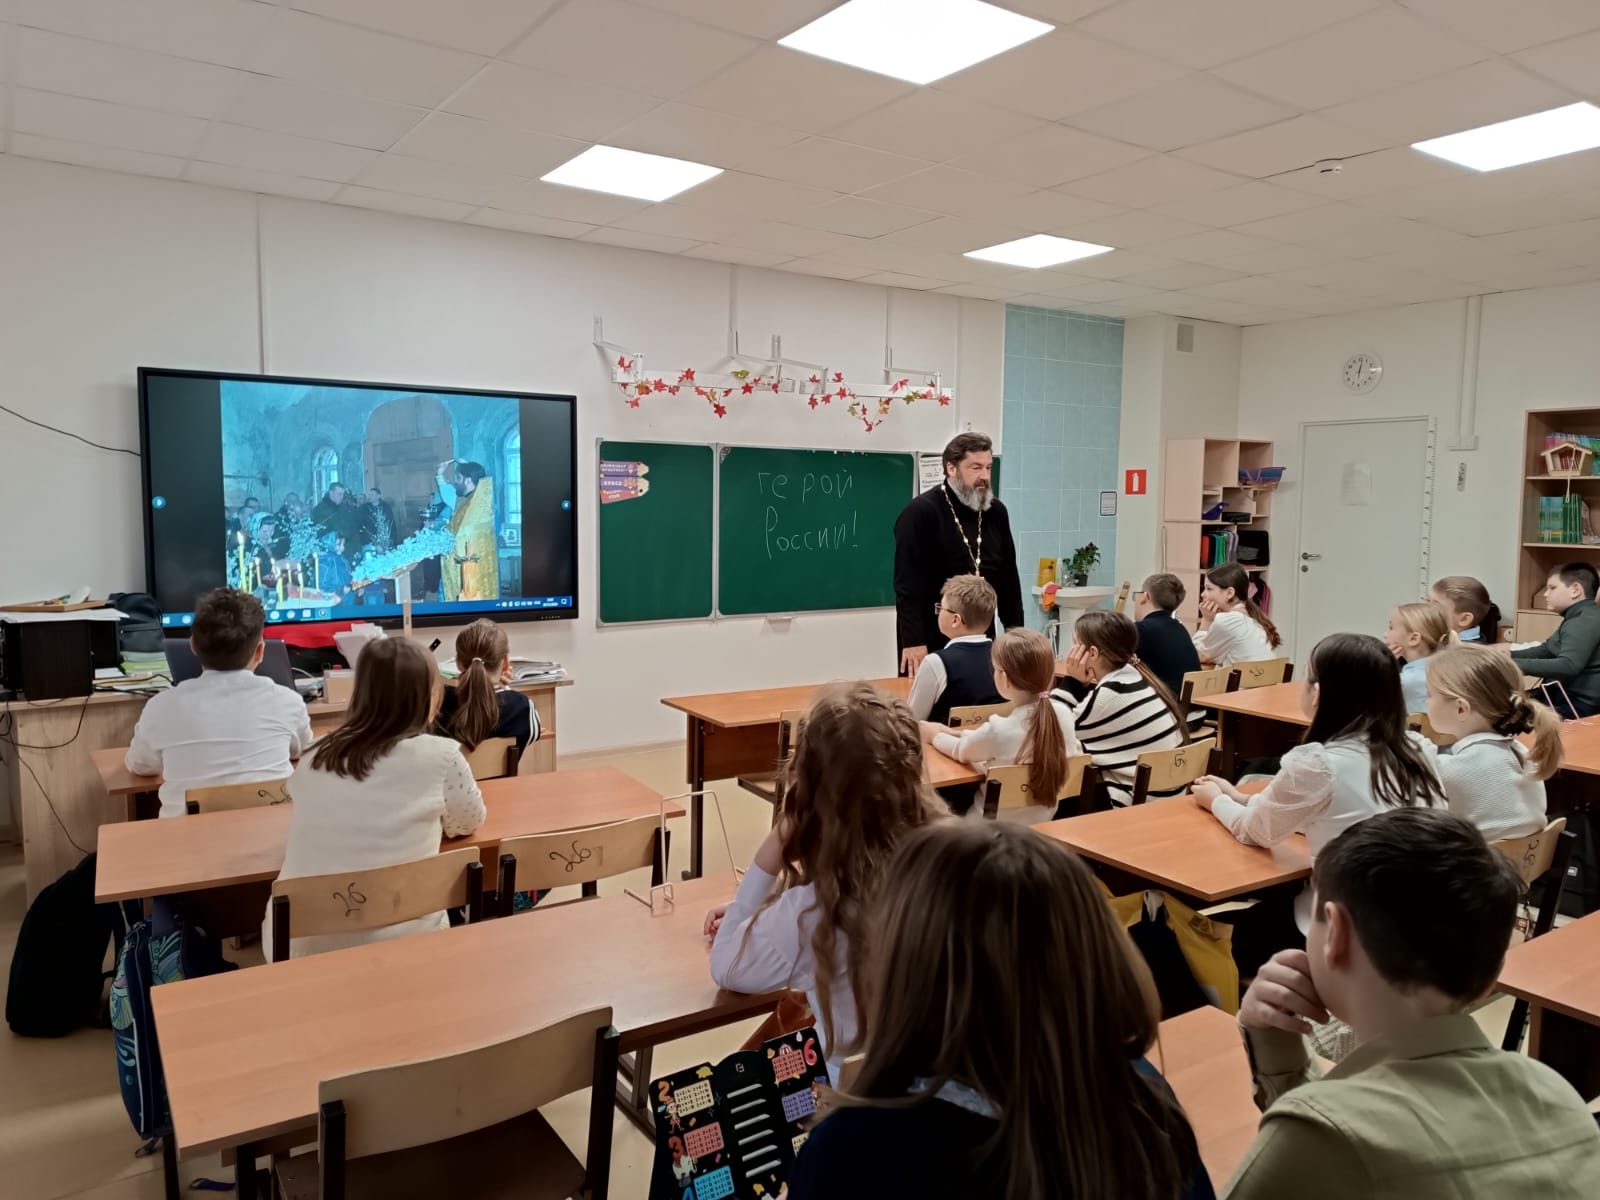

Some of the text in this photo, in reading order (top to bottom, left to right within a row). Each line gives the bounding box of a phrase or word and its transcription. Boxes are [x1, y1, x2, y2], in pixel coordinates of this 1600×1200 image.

[765, 505, 860, 560] России!
[803, 1037, 818, 1066] 6
[658, 1080, 673, 1103] 2
